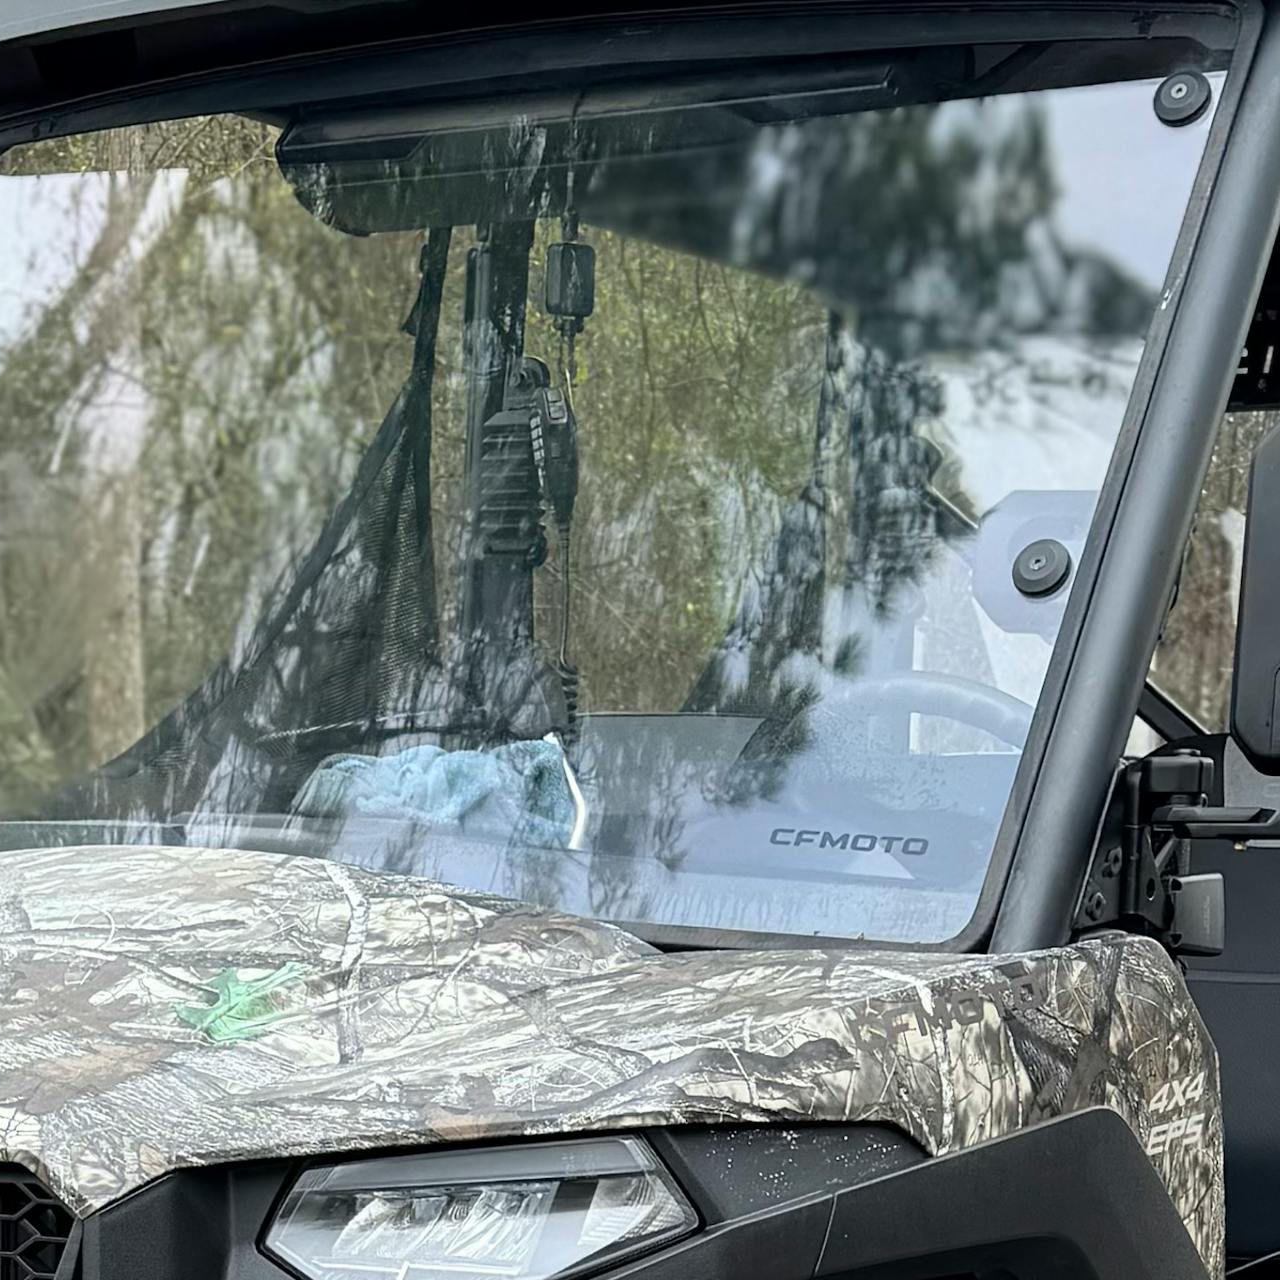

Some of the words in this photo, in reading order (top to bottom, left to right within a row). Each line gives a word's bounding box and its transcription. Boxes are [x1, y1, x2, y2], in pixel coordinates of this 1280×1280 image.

[770, 828, 930, 856] CFMOTO
[1148, 1071, 1206, 1114] 4X4
[1146, 1113, 1205, 1156] EPS
